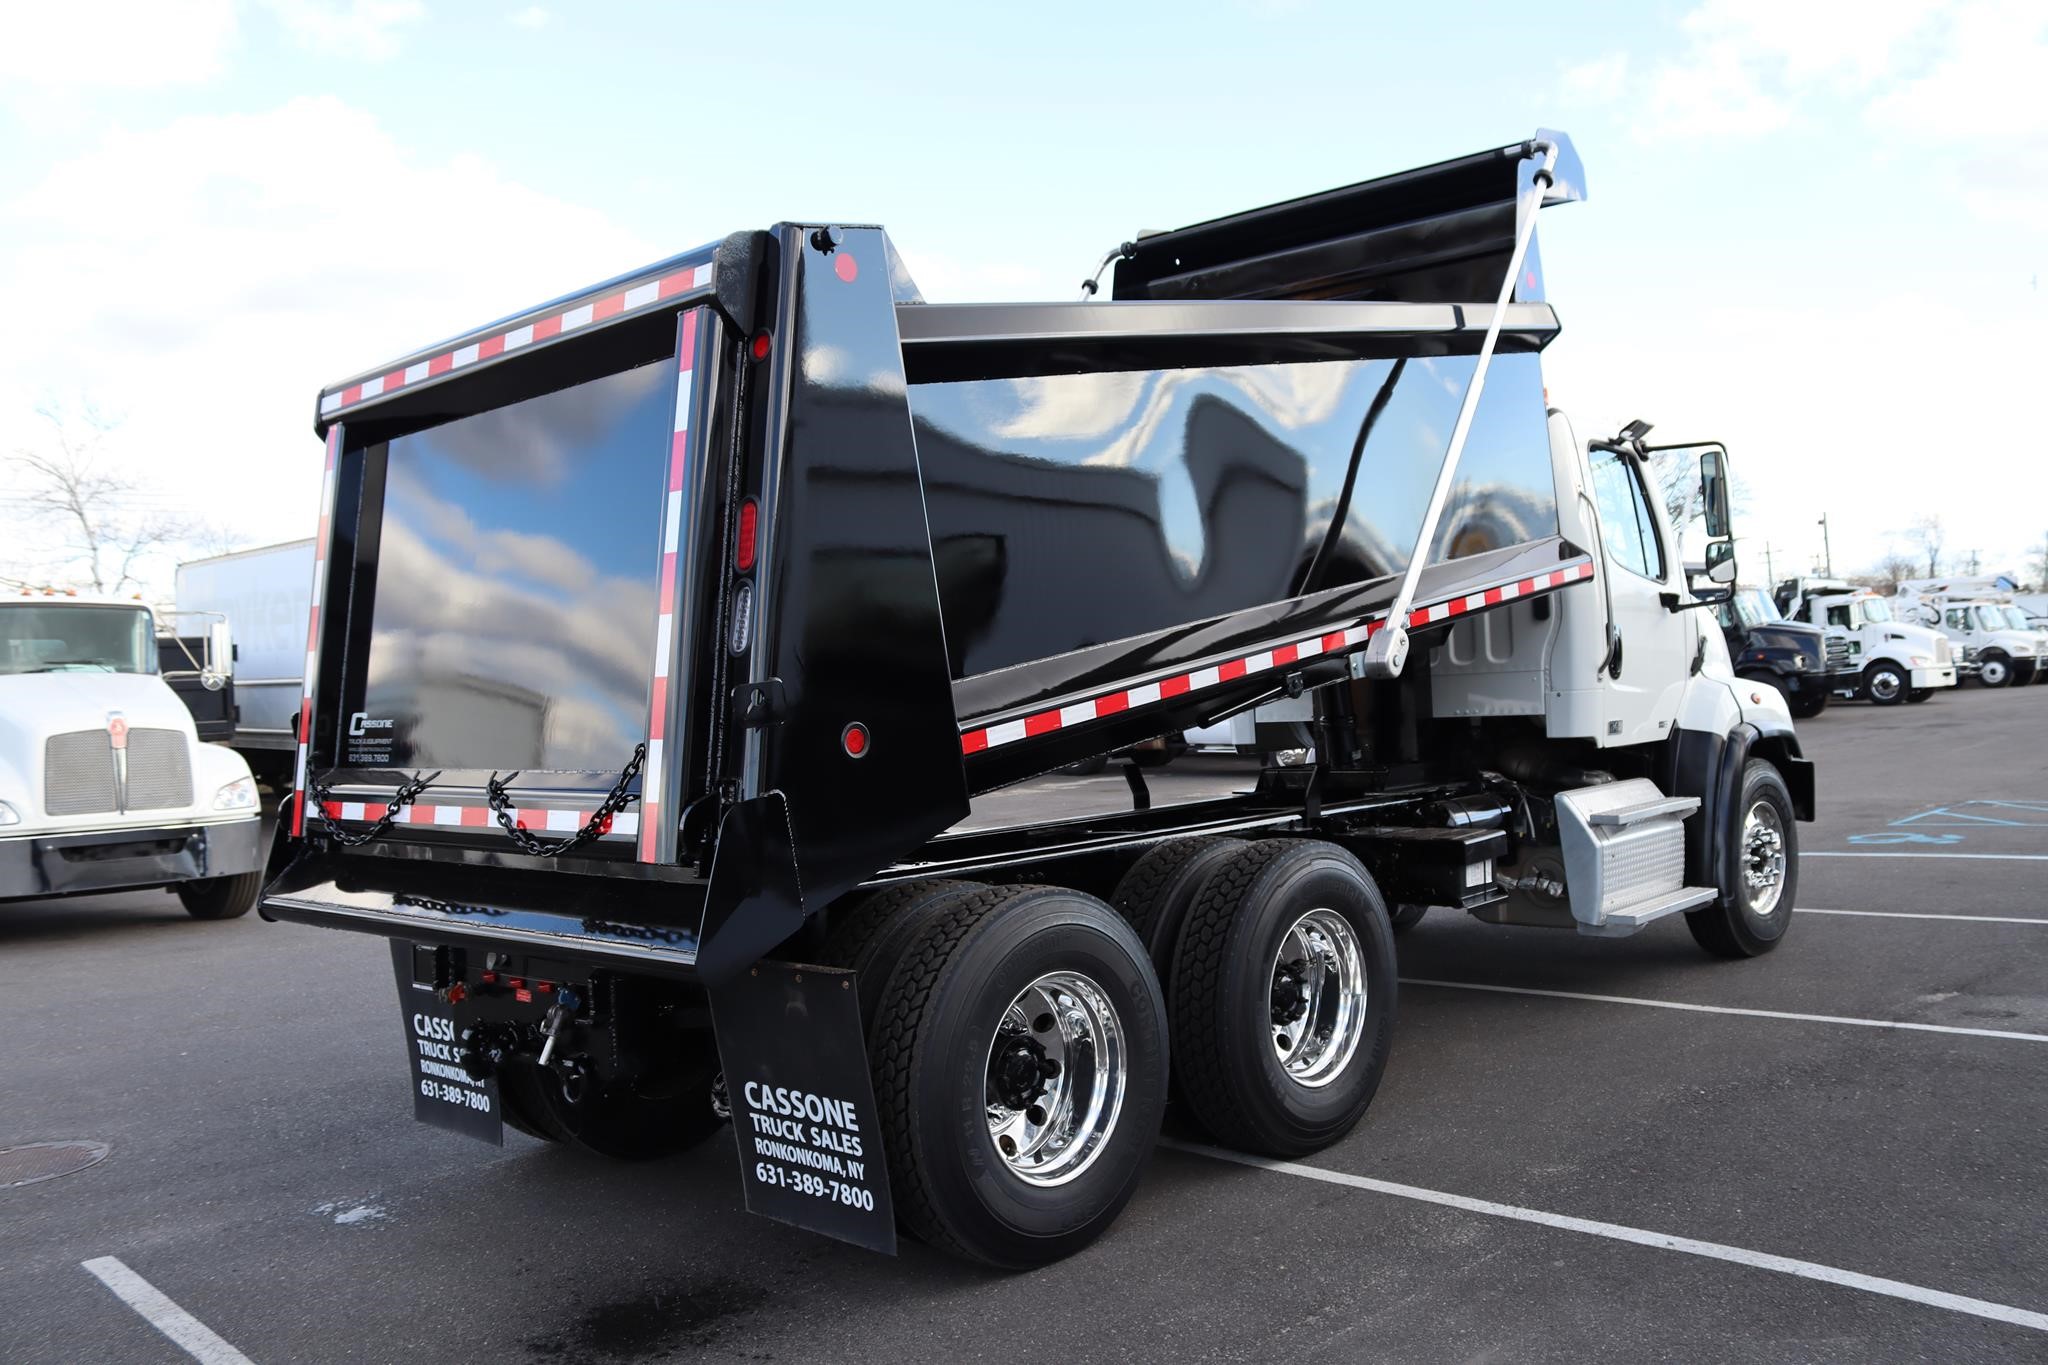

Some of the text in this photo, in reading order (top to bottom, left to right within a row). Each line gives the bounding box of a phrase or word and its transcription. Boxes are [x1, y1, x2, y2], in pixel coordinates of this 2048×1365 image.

[348, 711, 394, 736] CASSONE
[413, 1013, 455, 1042] CASS
[416, 1039, 452, 1062] TRUCK
[421, 1079, 490, 1113] 631-389-7800
[744, 1081, 860, 1132] CASSONE
[749, 1112, 863, 1157] TRUCK SALES
[754, 1137, 865, 1181] RONKONKOMA, NY
[756, 1162, 874, 1212] 631-389-7800
